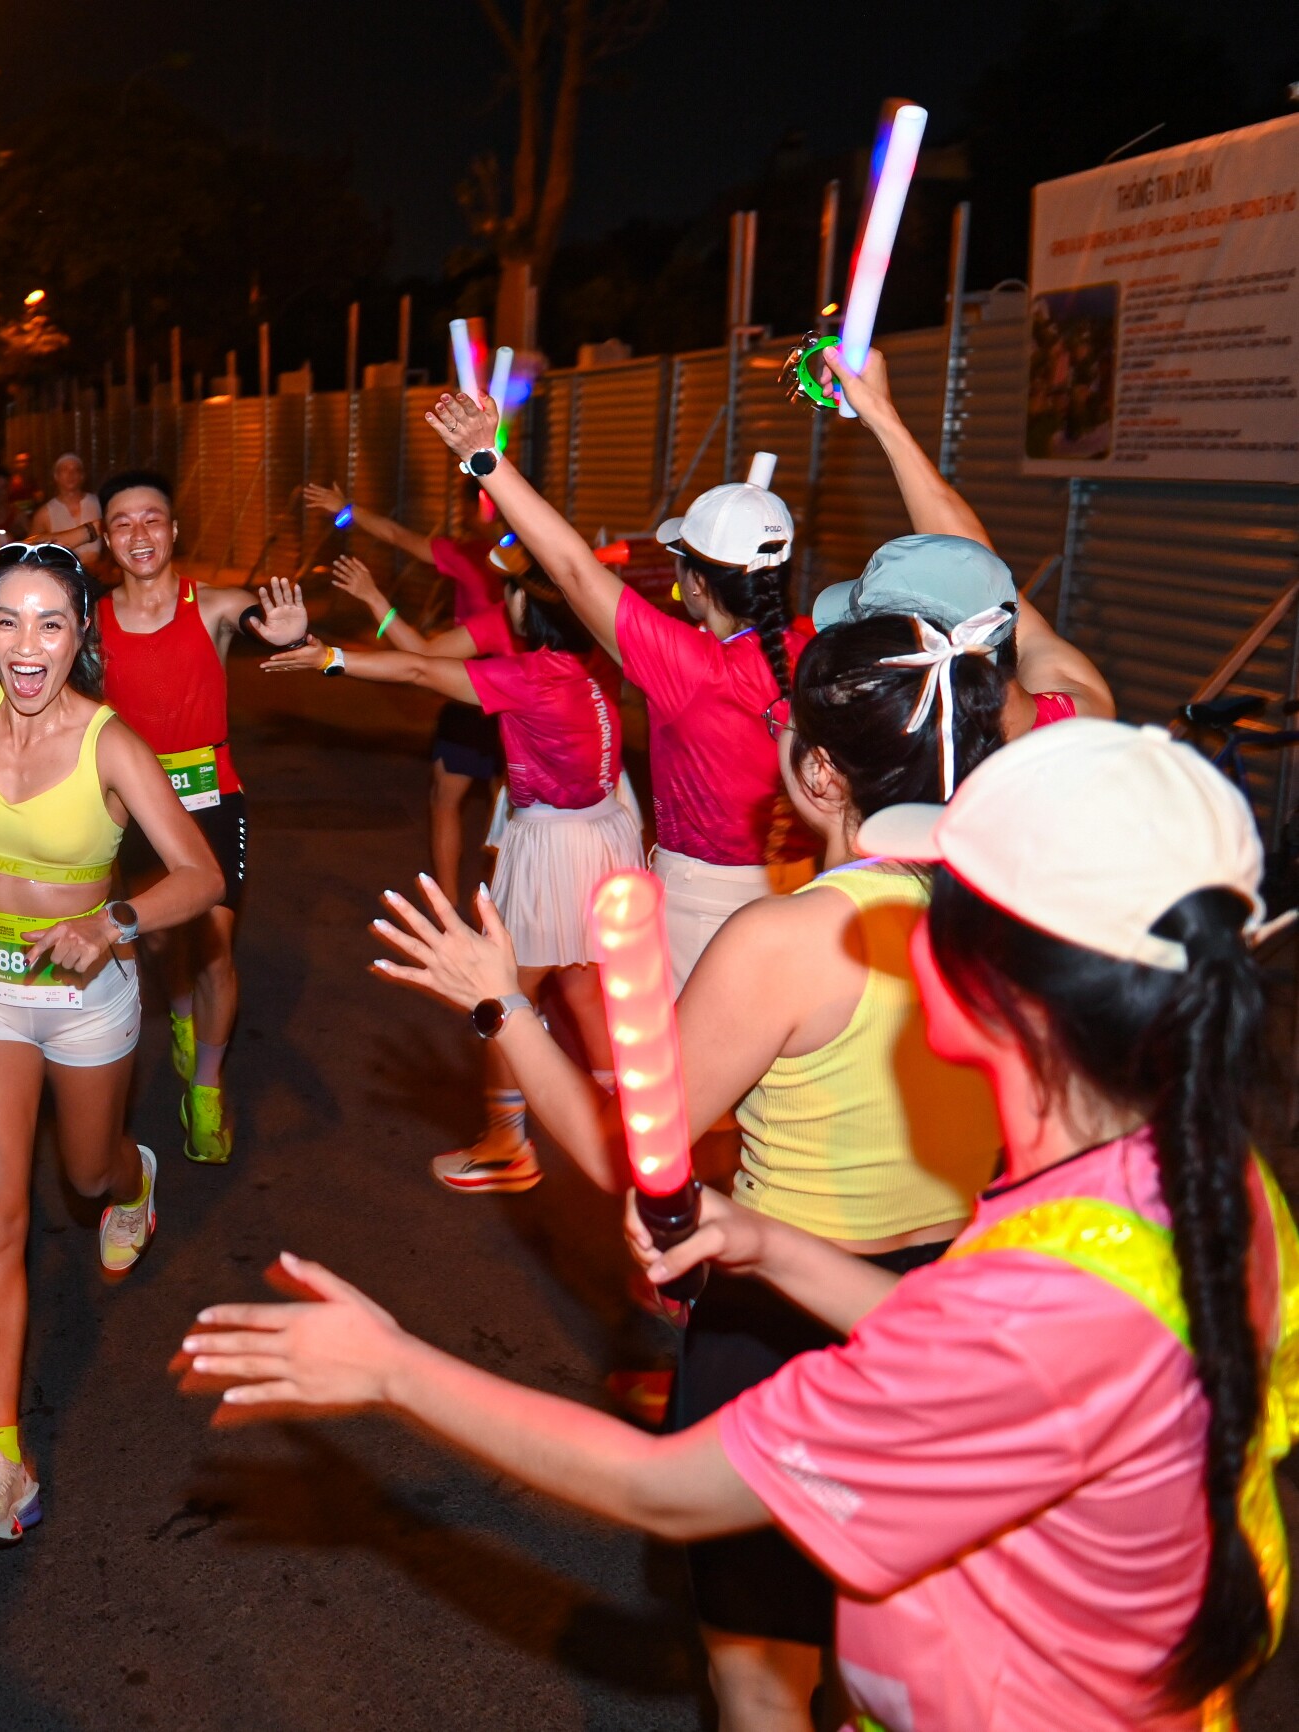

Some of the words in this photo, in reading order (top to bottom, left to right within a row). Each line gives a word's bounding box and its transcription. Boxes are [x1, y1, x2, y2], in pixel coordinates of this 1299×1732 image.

[168, 772, 192, 790] 81
[65, 867, 103, 881] NIKE
[68, 992, 76, 1002] F
